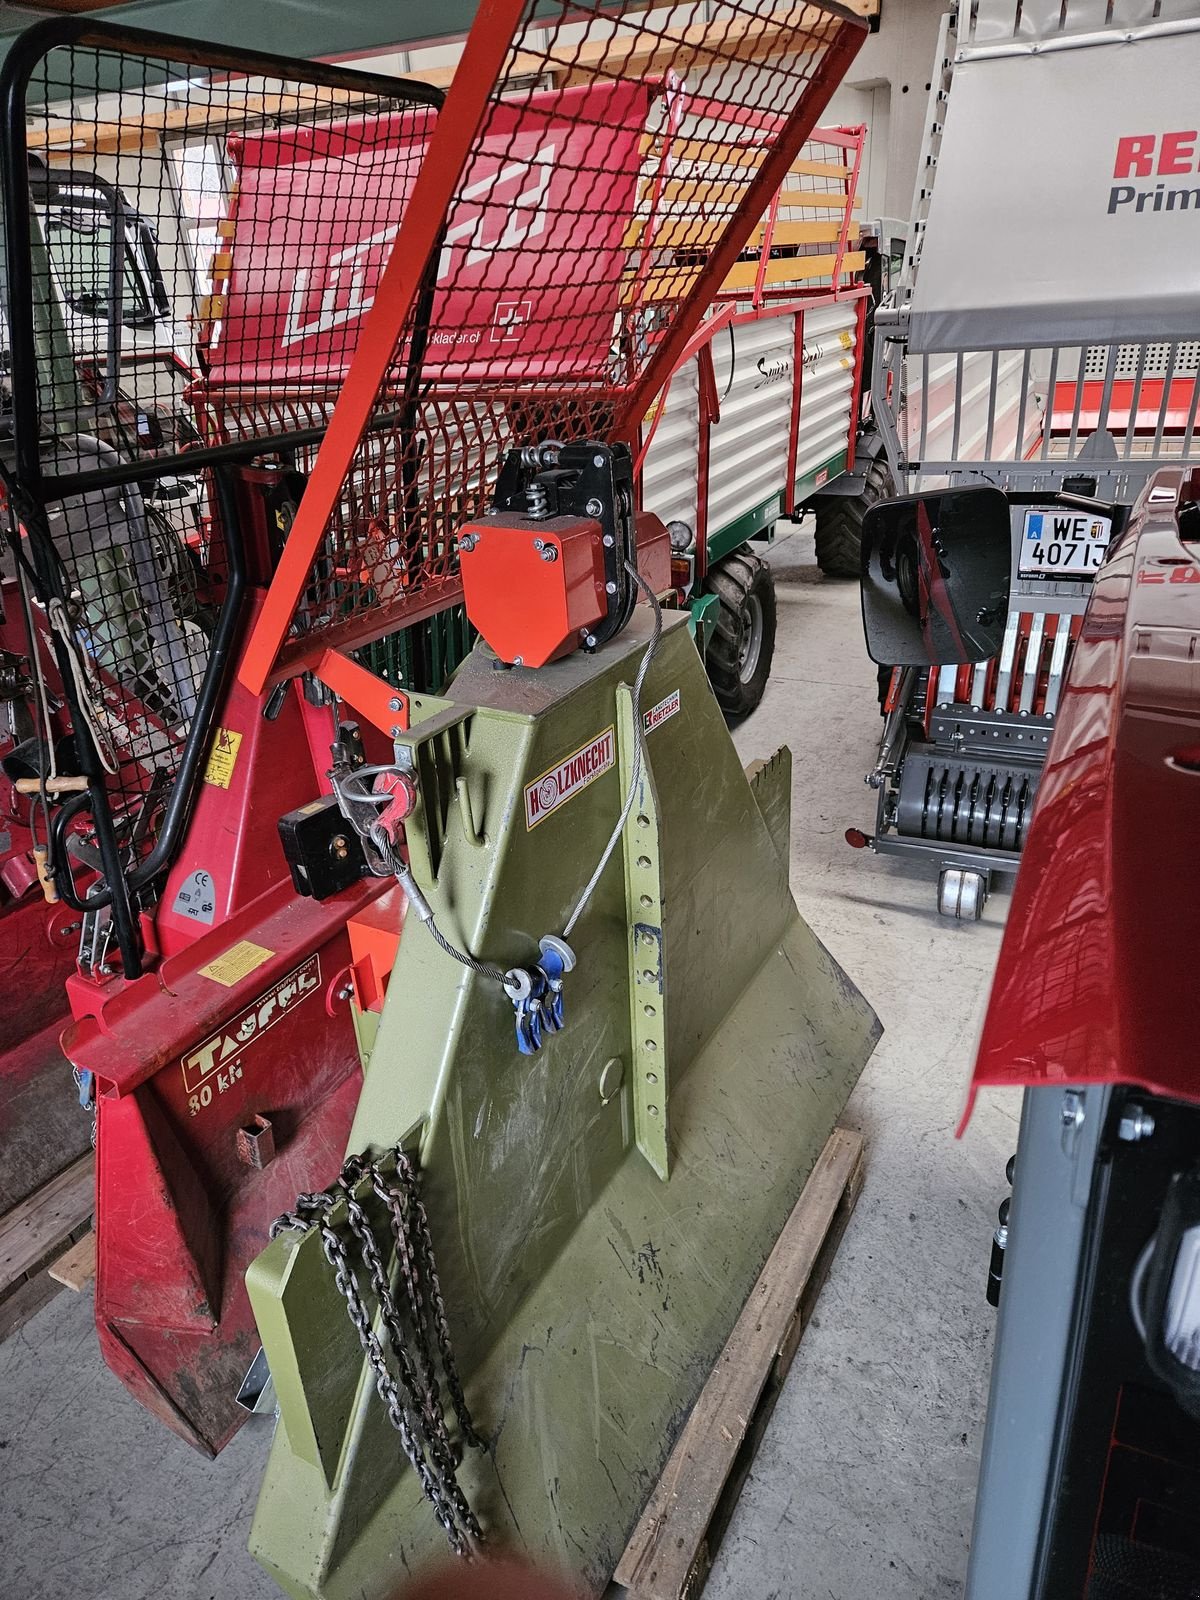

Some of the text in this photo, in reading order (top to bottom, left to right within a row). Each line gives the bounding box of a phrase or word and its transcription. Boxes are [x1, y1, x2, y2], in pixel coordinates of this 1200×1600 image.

[1113, 130, 1200, 179] RE
[1053, 517, 1088, 541] WE
[1032, 542, 1078, 567] 407
[529, 734, 612, 817] HOLZKNECHT
